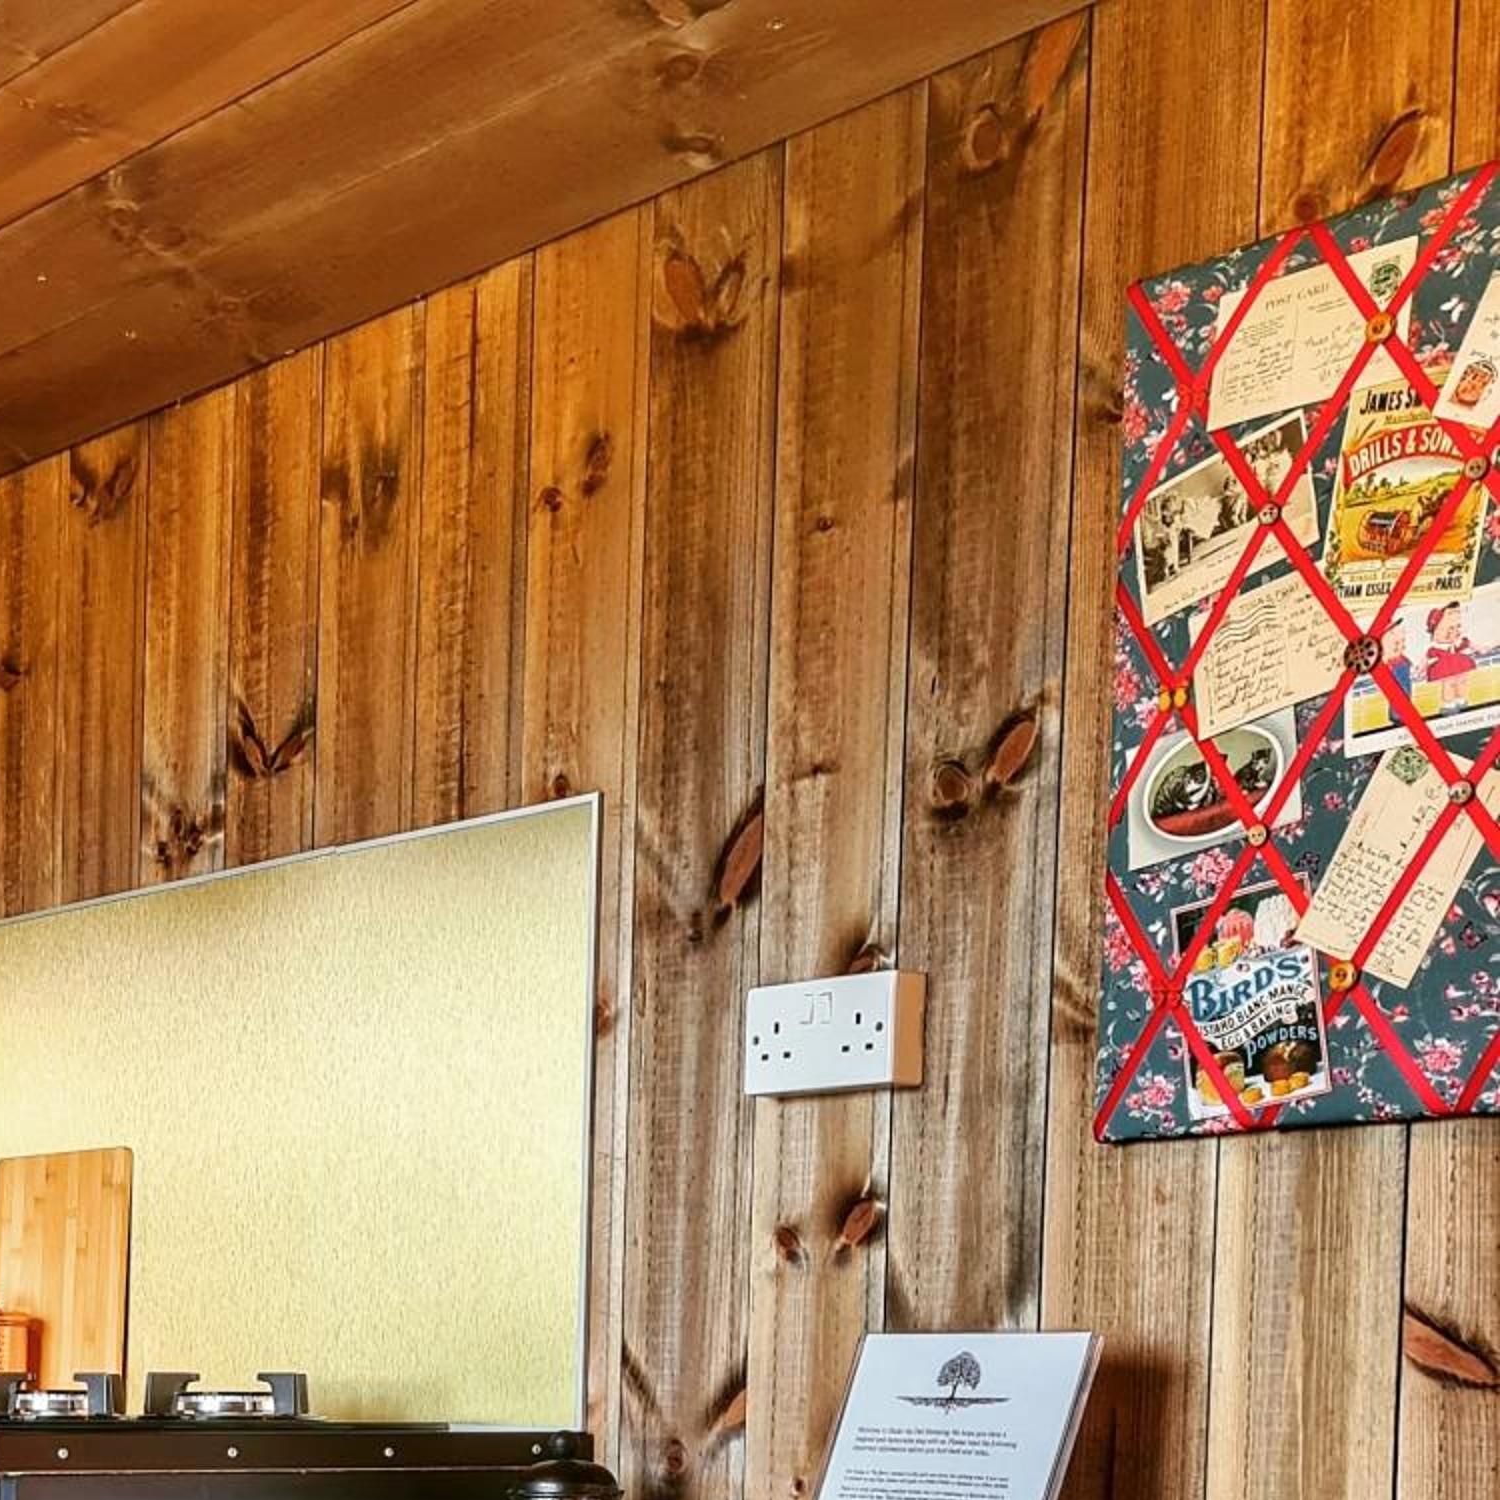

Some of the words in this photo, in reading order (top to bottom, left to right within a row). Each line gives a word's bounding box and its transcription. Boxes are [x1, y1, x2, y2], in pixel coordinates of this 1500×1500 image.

[1360, 389, 1403, 414] JAMES
[1351, 431, 1403, 477] DRILLS
[1405, 429, 1417, 454] &
[1434, 574, 1463, 590] PARIS
[1187, 956, 1302, 1022] BIRD'S
[1243, 1026, 1317, 1069] POWDERS
